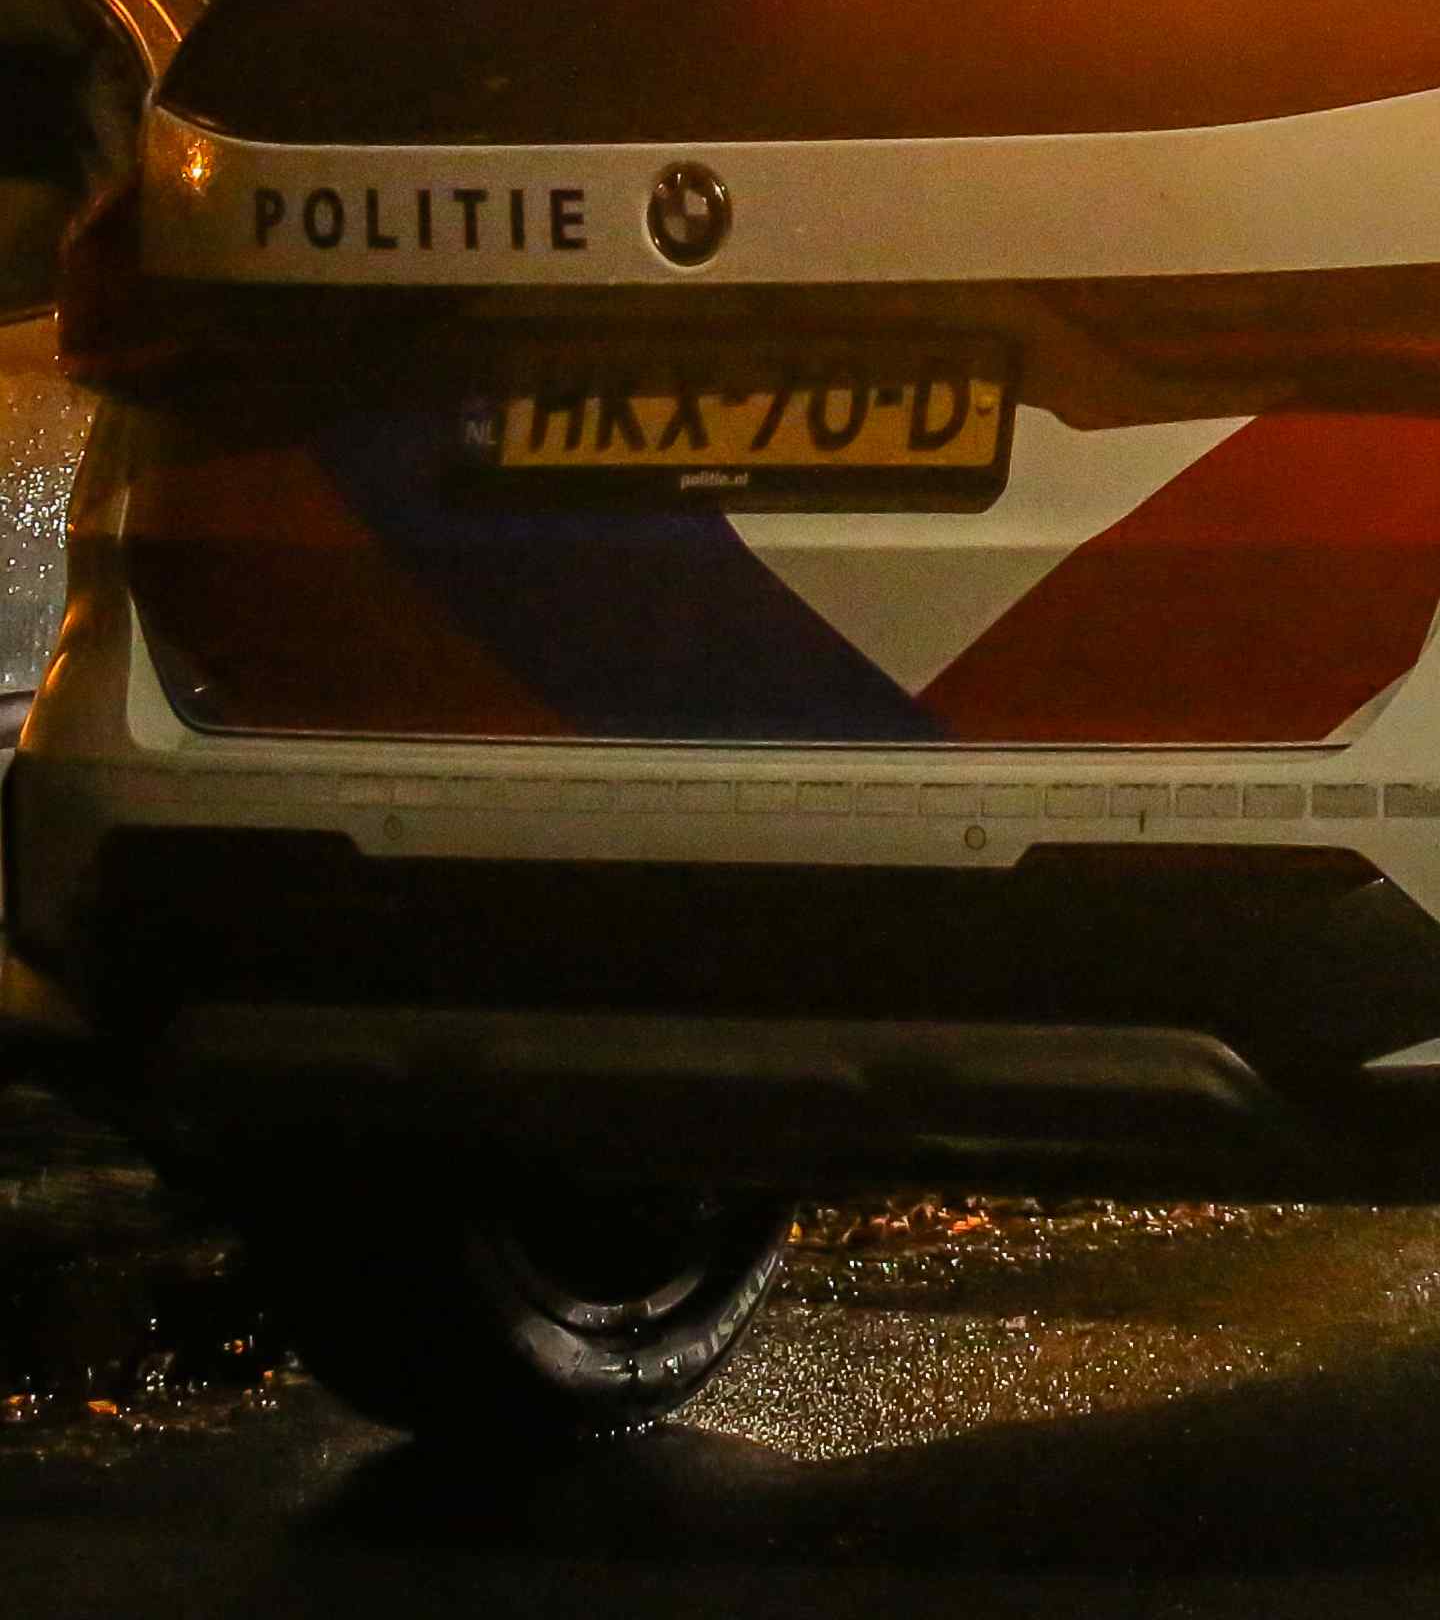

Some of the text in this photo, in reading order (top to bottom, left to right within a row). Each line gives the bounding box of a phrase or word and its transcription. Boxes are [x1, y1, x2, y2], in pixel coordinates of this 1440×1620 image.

[254, 187, 589, 252] POLITIE
[464, 375, 972, 453] NL HKX-70-D
[679, 470, 750, 491] politie.nl
